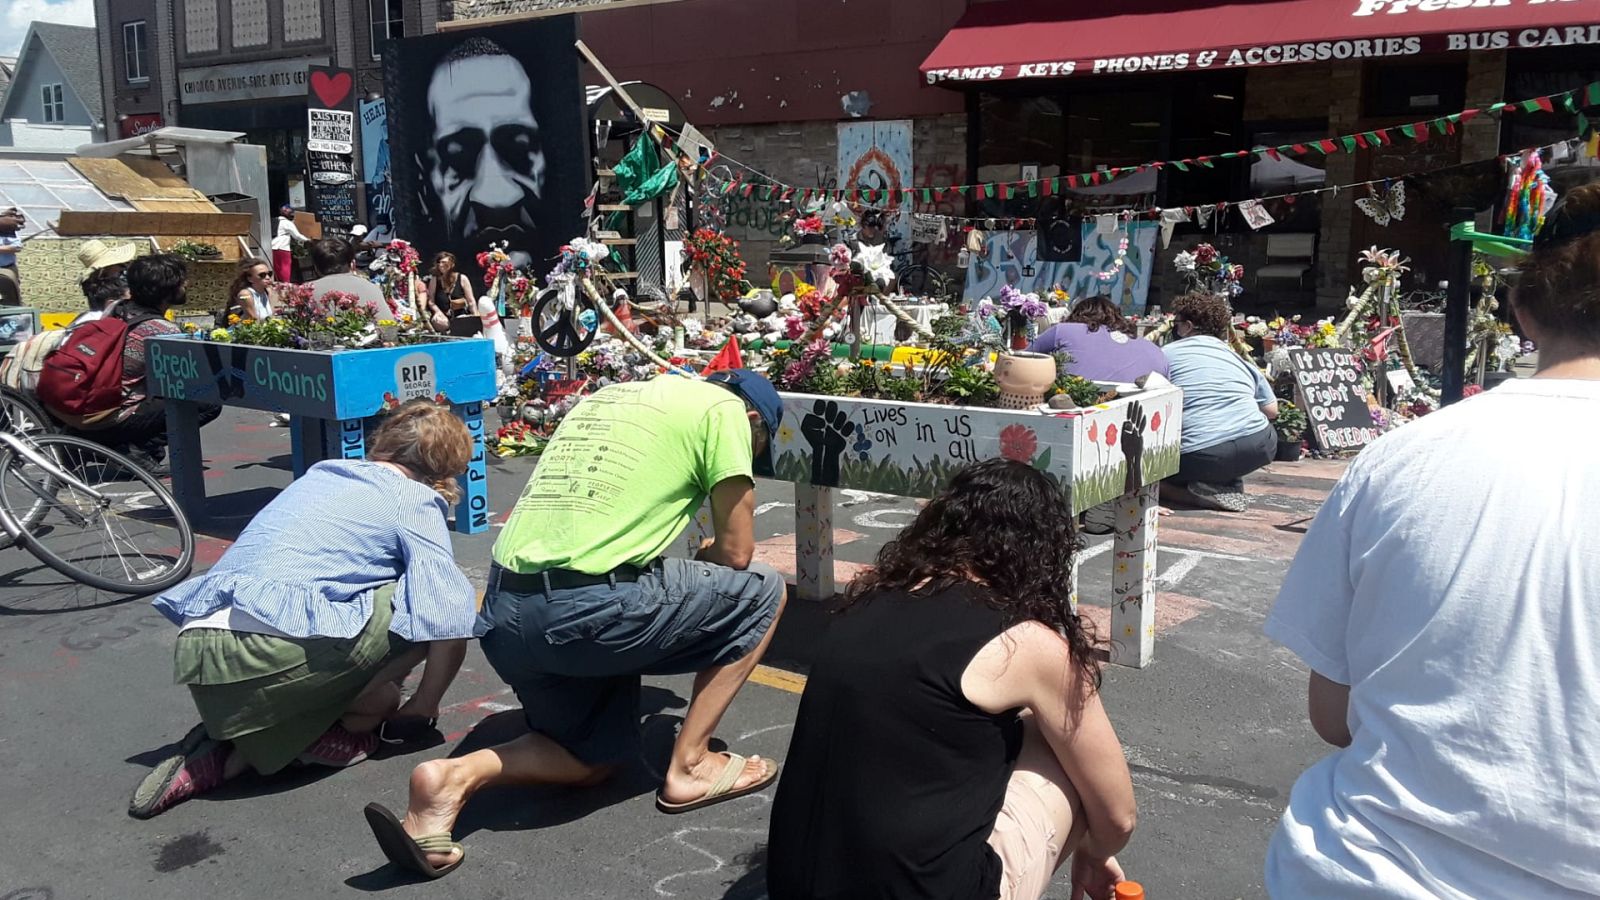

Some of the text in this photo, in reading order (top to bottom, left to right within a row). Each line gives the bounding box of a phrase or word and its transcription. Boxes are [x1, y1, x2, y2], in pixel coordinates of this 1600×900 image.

[1447, 30, 1509, 50] BUS
[926, 37, 1421, 84] STAMPS KEYS PHONES & ACCESSORIES
[184, 79, 215, 94] CHICAGO
[218, 75, 246, 92] AVENUE
[269, 72, 290, 86] ARTS
[313, 111, 350, 123] JUSTICE
[363, 103, 385, 125] HEAT
[151, 343, 199, 379] Break
[1295, 351, 1313, 369] It
[254, 357, 327, 401] Chains
[402, 365, 427, 383] RIP
[1335, 367, 1357, 382] to
[159, 373, 186, 400] The
[404, 381, 432, 390] GEORGE
[406, 389, 431, 397] FLOYD
[915, 418, 936, 443] in
[948, 438, 980, 463] all
[467, 402, 487, 528] NO PEACE
